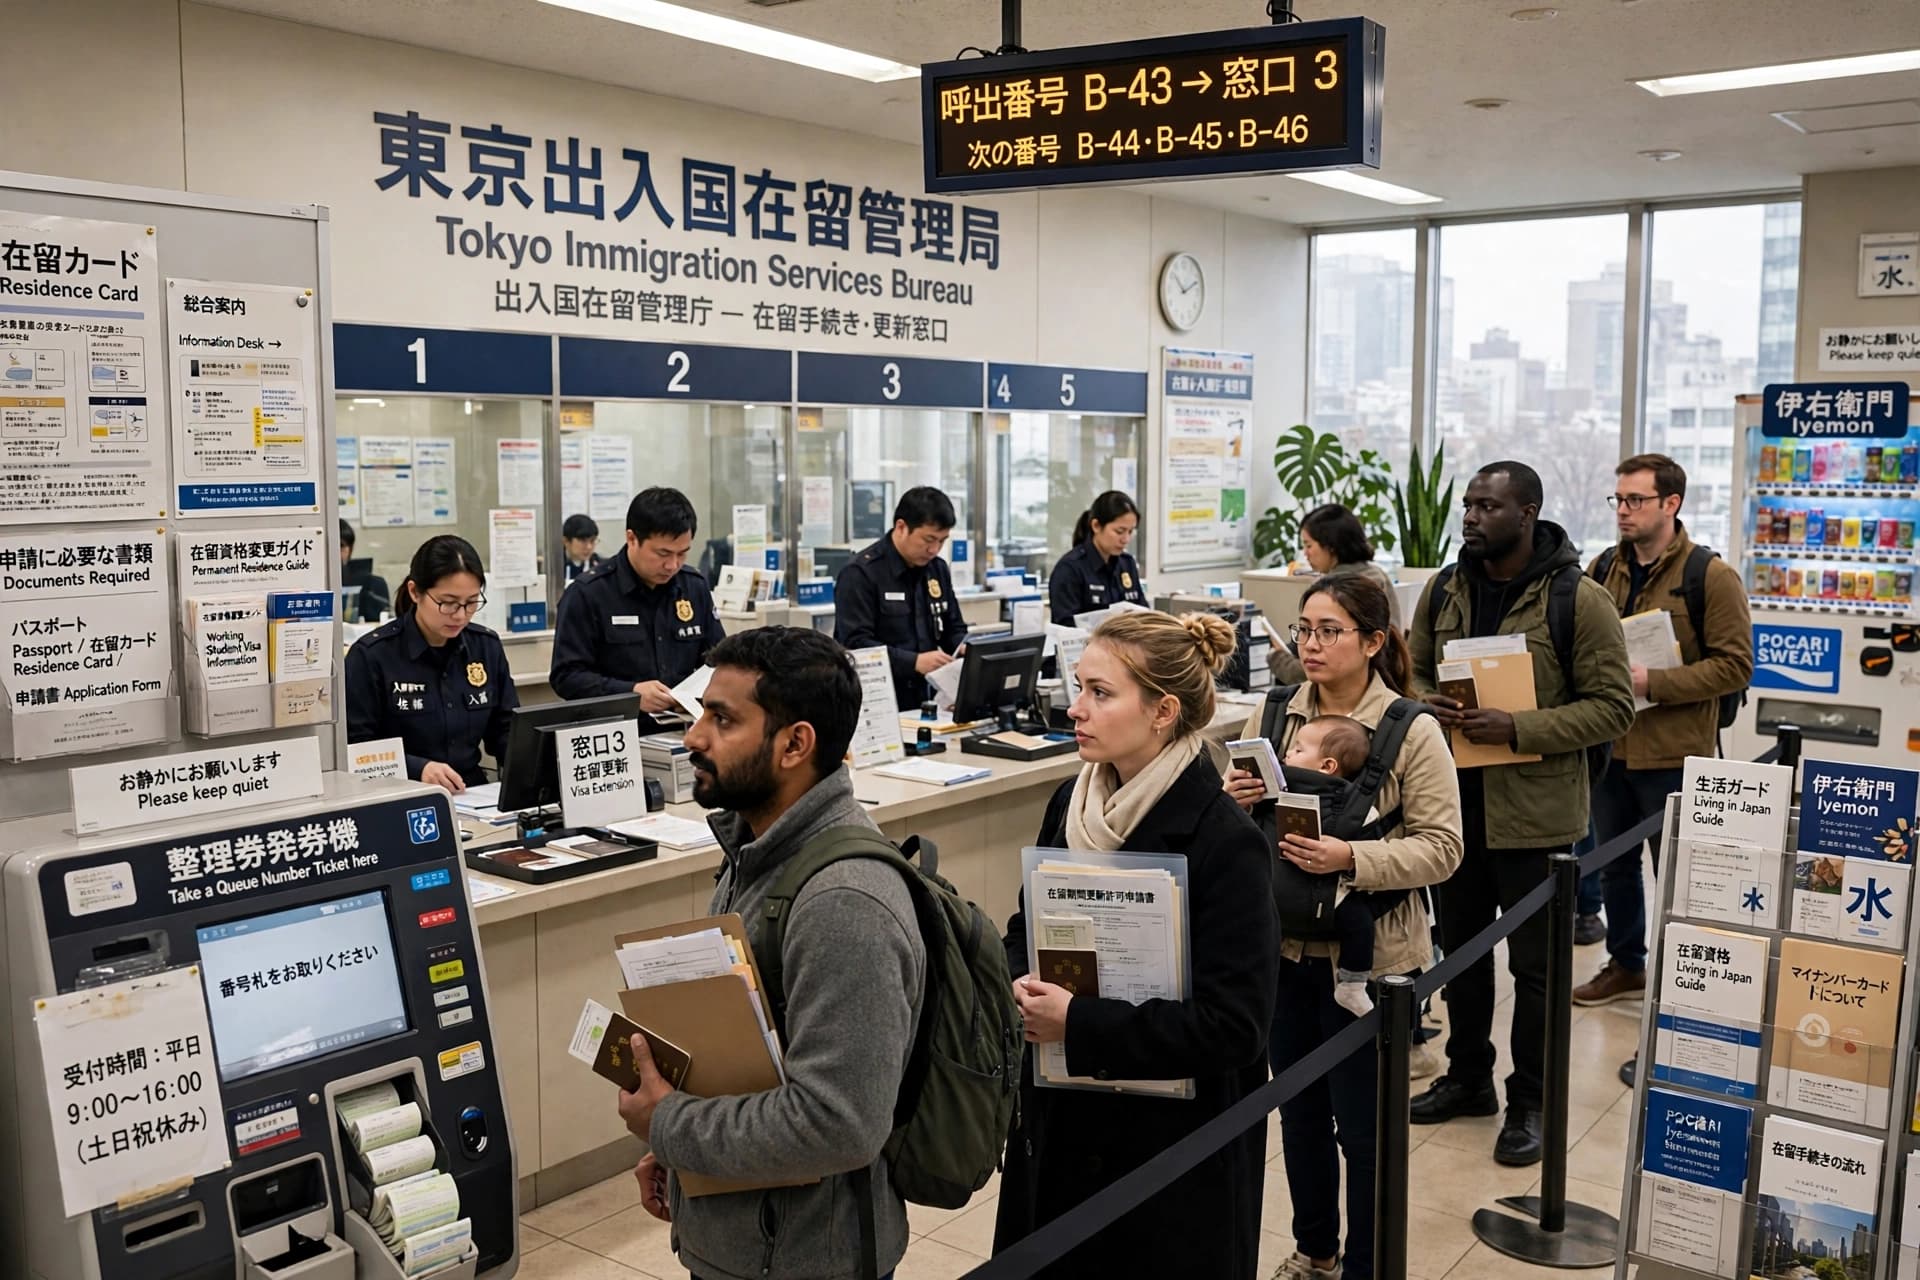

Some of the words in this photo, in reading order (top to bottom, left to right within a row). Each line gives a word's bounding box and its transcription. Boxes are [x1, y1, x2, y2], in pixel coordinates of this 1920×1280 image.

[941, 75, 1069, 124] 呼出番号
[1084, 66, 1172, 112] B-43
[1223, 55, 1296, 100] 窓口
[1314, 50, 1338, 90] 3
[967, 136, 1061, 169] 次の番号
[374, 110, 1001, 271] 東京出入国在留管理局
[1, 239, 139, 279] 在留カード
[436, 215, 552, 270] Tokyo
[565, 230, 757, 284] Immigration
[768, 253, 883, 297] Services
[892, 269, 974, 306] Bureau
[0, 276, 93, 299] Residence
[98, 284, 138, 302] Card
[183, 294, 246, 316] 総合案内
[494, 279, 714, 328] 出入国在留管理庁
[752, 302, 949, 343] 在留手続き・更新窓口
[178, 334, 234, 350] Information
[237, 337, 264, 350] Desk
[1826, 332, 1920, 347] おかにおいし
[407, 337, 427, 384] 1
[1829, 349, 1864, 360] Please
[1867, 348, 1894, 362] keep
[667, 351, 691, 392] 2
[882, 362, 902, 400] 3
[997, 374, 1012, 403] 4
[1060, 373, 1076, 406] 5
[1776, 390, 1894, 418] 伊右衛門
[1792, 417, 1875, 435] Iyemon
[0, 543, 153, 571] 申請に必要な書類
[190, 539, 313, 562] 在留資格変更ガイド
[3, 571, 85, 590] Documents
[89, 568, 150, 587] Required
[192, 563, 239, 576] Permanent
[241, 560, 283, 574] Residence
[286, 559, 310, 571] Guide
[11, 616, 87, 637] パスポート
[206, 631, 244, 642] Working
[12, 639, 73, 659] Passport
[90, 631, 157, 653] 在留カード
[206, 643, 242, 656] Student
[244, 640, 262, 652] Visa
[1758, 633, 1830, 652] POCARI
[13, 658, 83, 677] Residence
[86, 656, 113, 670] Card
[206, 655, 257, 669] Information
[1757, 647, 1824, 667] SWEAT
[16, 687, 60, 707] 申請書
[64, 681, 129, 702] Application
[132, 678, 161, 692] Form
[571, 731, 625, 760] 窓口3
[119, 750, 281, 792] お静かにお願いします
[573, 757, 629, 782] 在留更新
[138, 790, 188, 809] Please
[193, 784, 228, 803] keep
[232, 776, 270, 796] quiet
[570, 784, 591, 798] Visa
[592, 778, 635, 795] Extension
[1695, 775, 1771, 798] 生活ガード
[1812, 774, 1895, 802] 伊右衛門
[1694, 795, 1725, 813] Living
[1727, 799, 1737, 810] in
[1740, 802, 1771, 816] Japan
[1817, 799, 1879, 818] Iyemon
[1692, 813, 1724, 827] Guide
[166, 817, 360, 883] 整理券発券機
[168, 887, 201, 904] Take
[205, 886, 214, 898] a
[216, 876, 259, 897] Queue
[262, 865, 312, 888] Number
[313, 858, 351, 877] Ticket
[353, 852, 379, 869] here
[1742, 887, 1764, 913] 水
[1845, 877, 1893, 922] 水
[1677, 943, 1731, 965] 在留資格
[219, 945, 379, 999] 番号札をお取りください
[1675, 977, 1706, 992] Guide
[1676, 961, 1706, 979] Living
[1709, 966, 1718, 978] in
[1721, 971, 1752, 986] Japan
[1791, 966, 1890, 994] マイナンバーカード
[1771, 1141, 1866, 1176] 在留手続きの流れ
